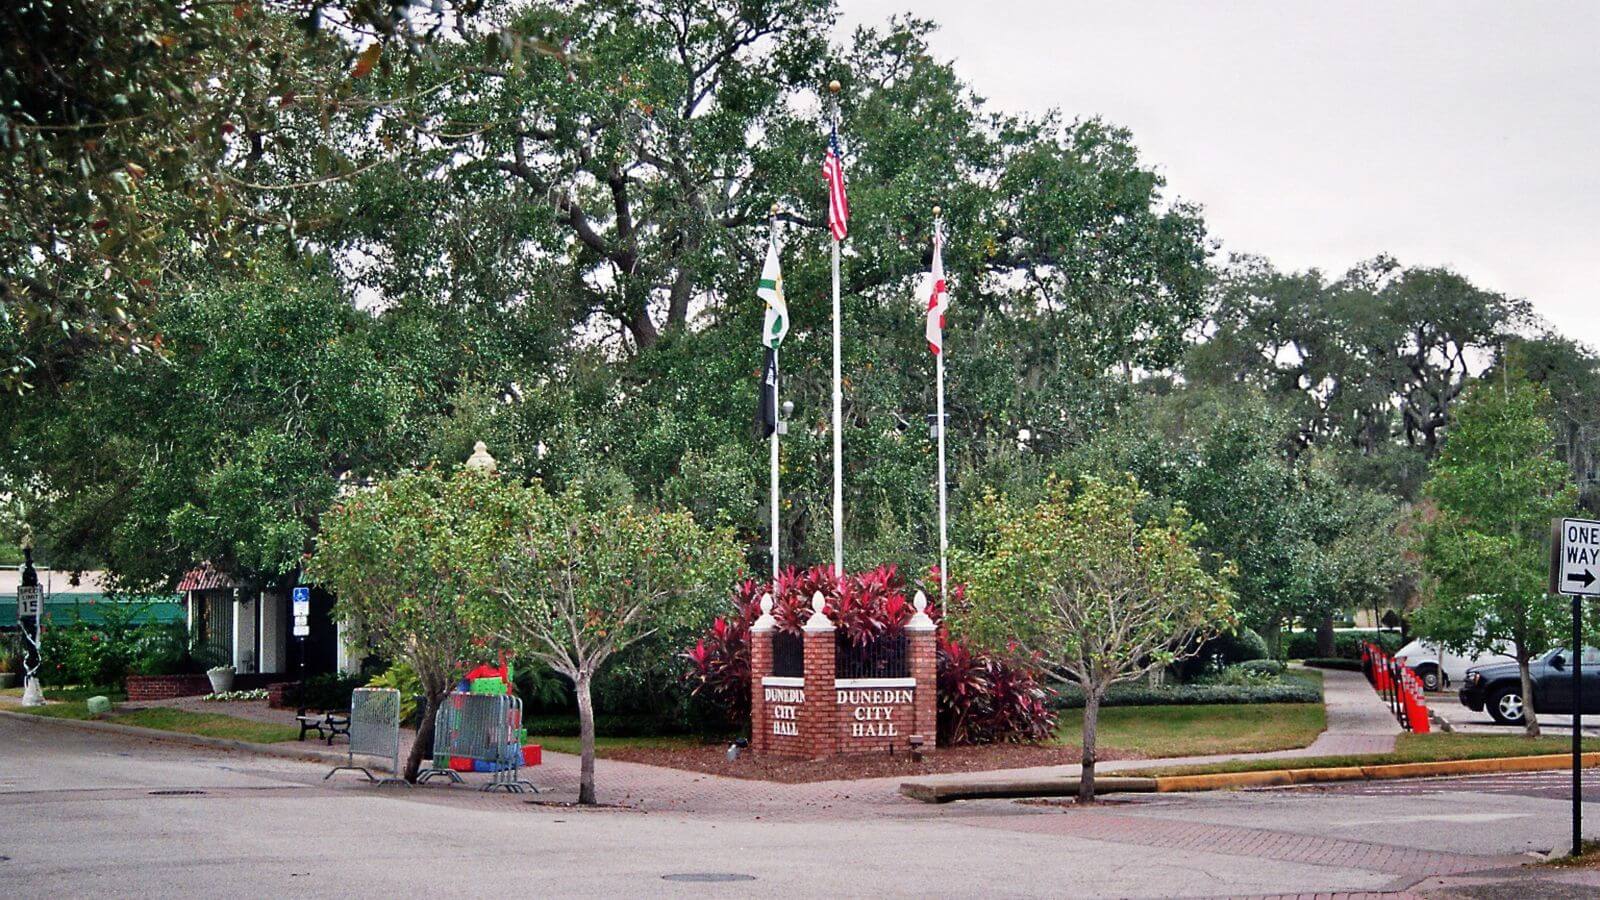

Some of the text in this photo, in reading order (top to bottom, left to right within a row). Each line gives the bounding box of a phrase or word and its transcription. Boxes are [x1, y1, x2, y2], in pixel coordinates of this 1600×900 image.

[1568, 526, 1599, 545] ONE
[1567, 546, 1599, 565] WAY
[23, 601, 38, 612] 15
[836, 690, 913, 704] DUNEDIN
[775, 705, 796, 719] CITY
[854, 706, 893, 720] CITY
[773, 721, 798, 736] HALL
[852, 722, 898, 736] HALL
